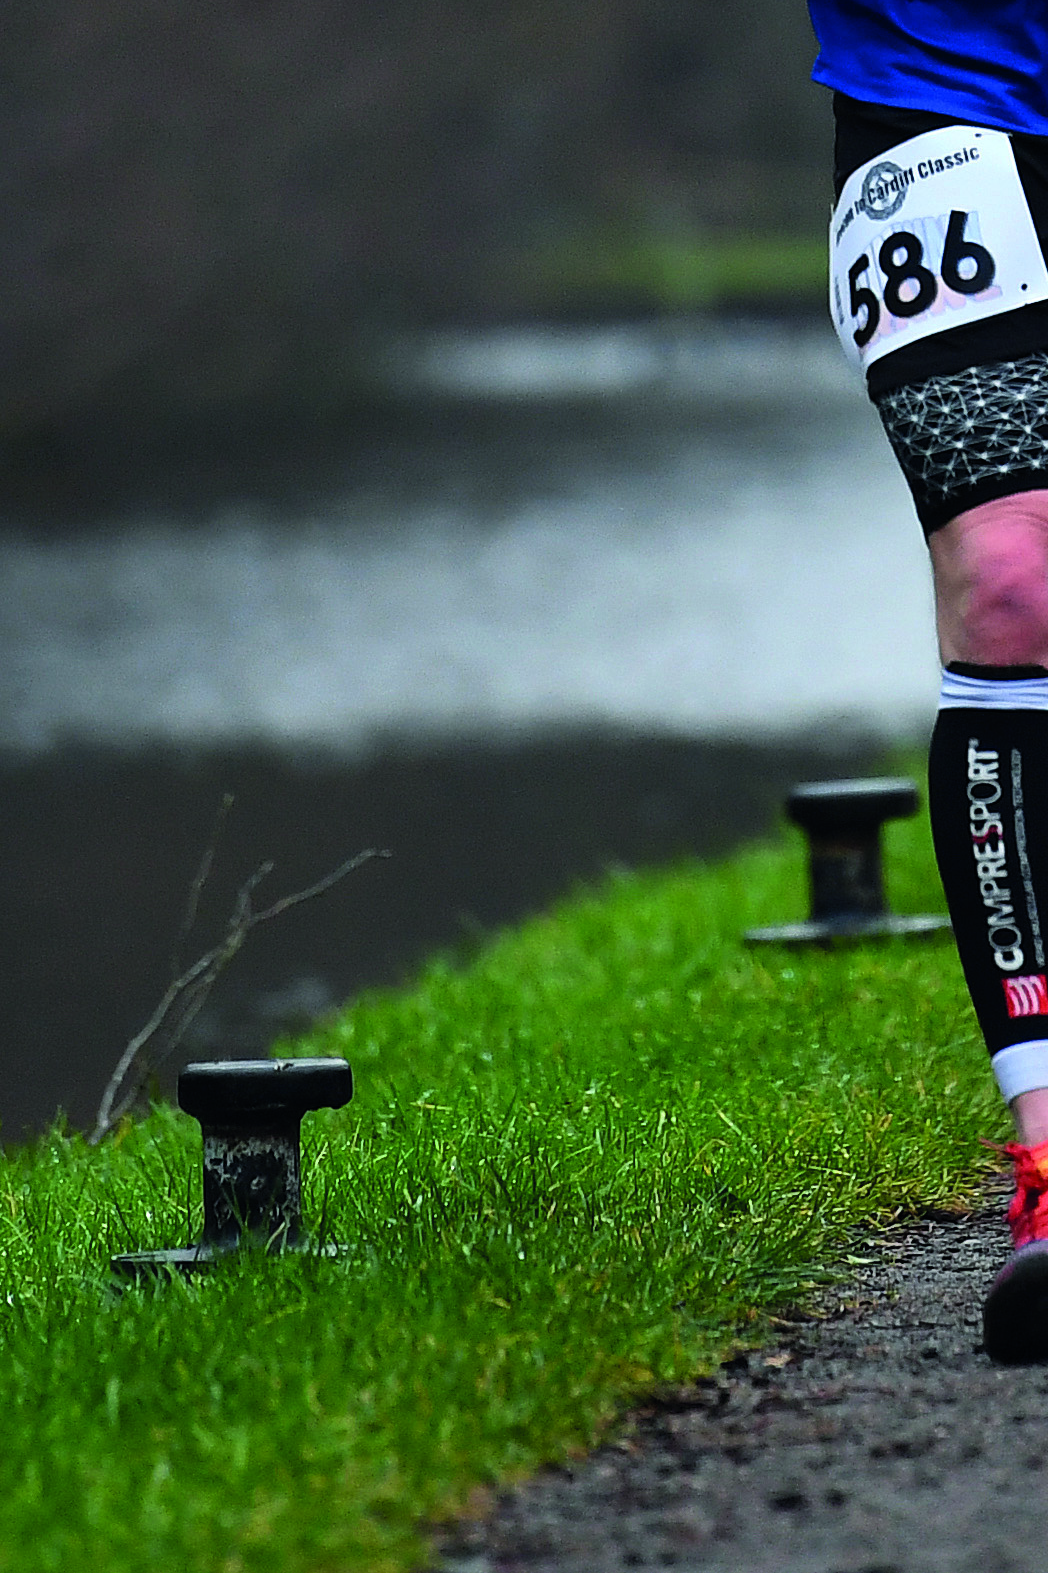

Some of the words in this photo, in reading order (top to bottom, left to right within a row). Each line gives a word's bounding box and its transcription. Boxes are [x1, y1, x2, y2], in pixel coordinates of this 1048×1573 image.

[867, 167, 915, 205] Cardiff
[917, 146, 980, 179] Classic
[848, 209, 996, 347] 586
